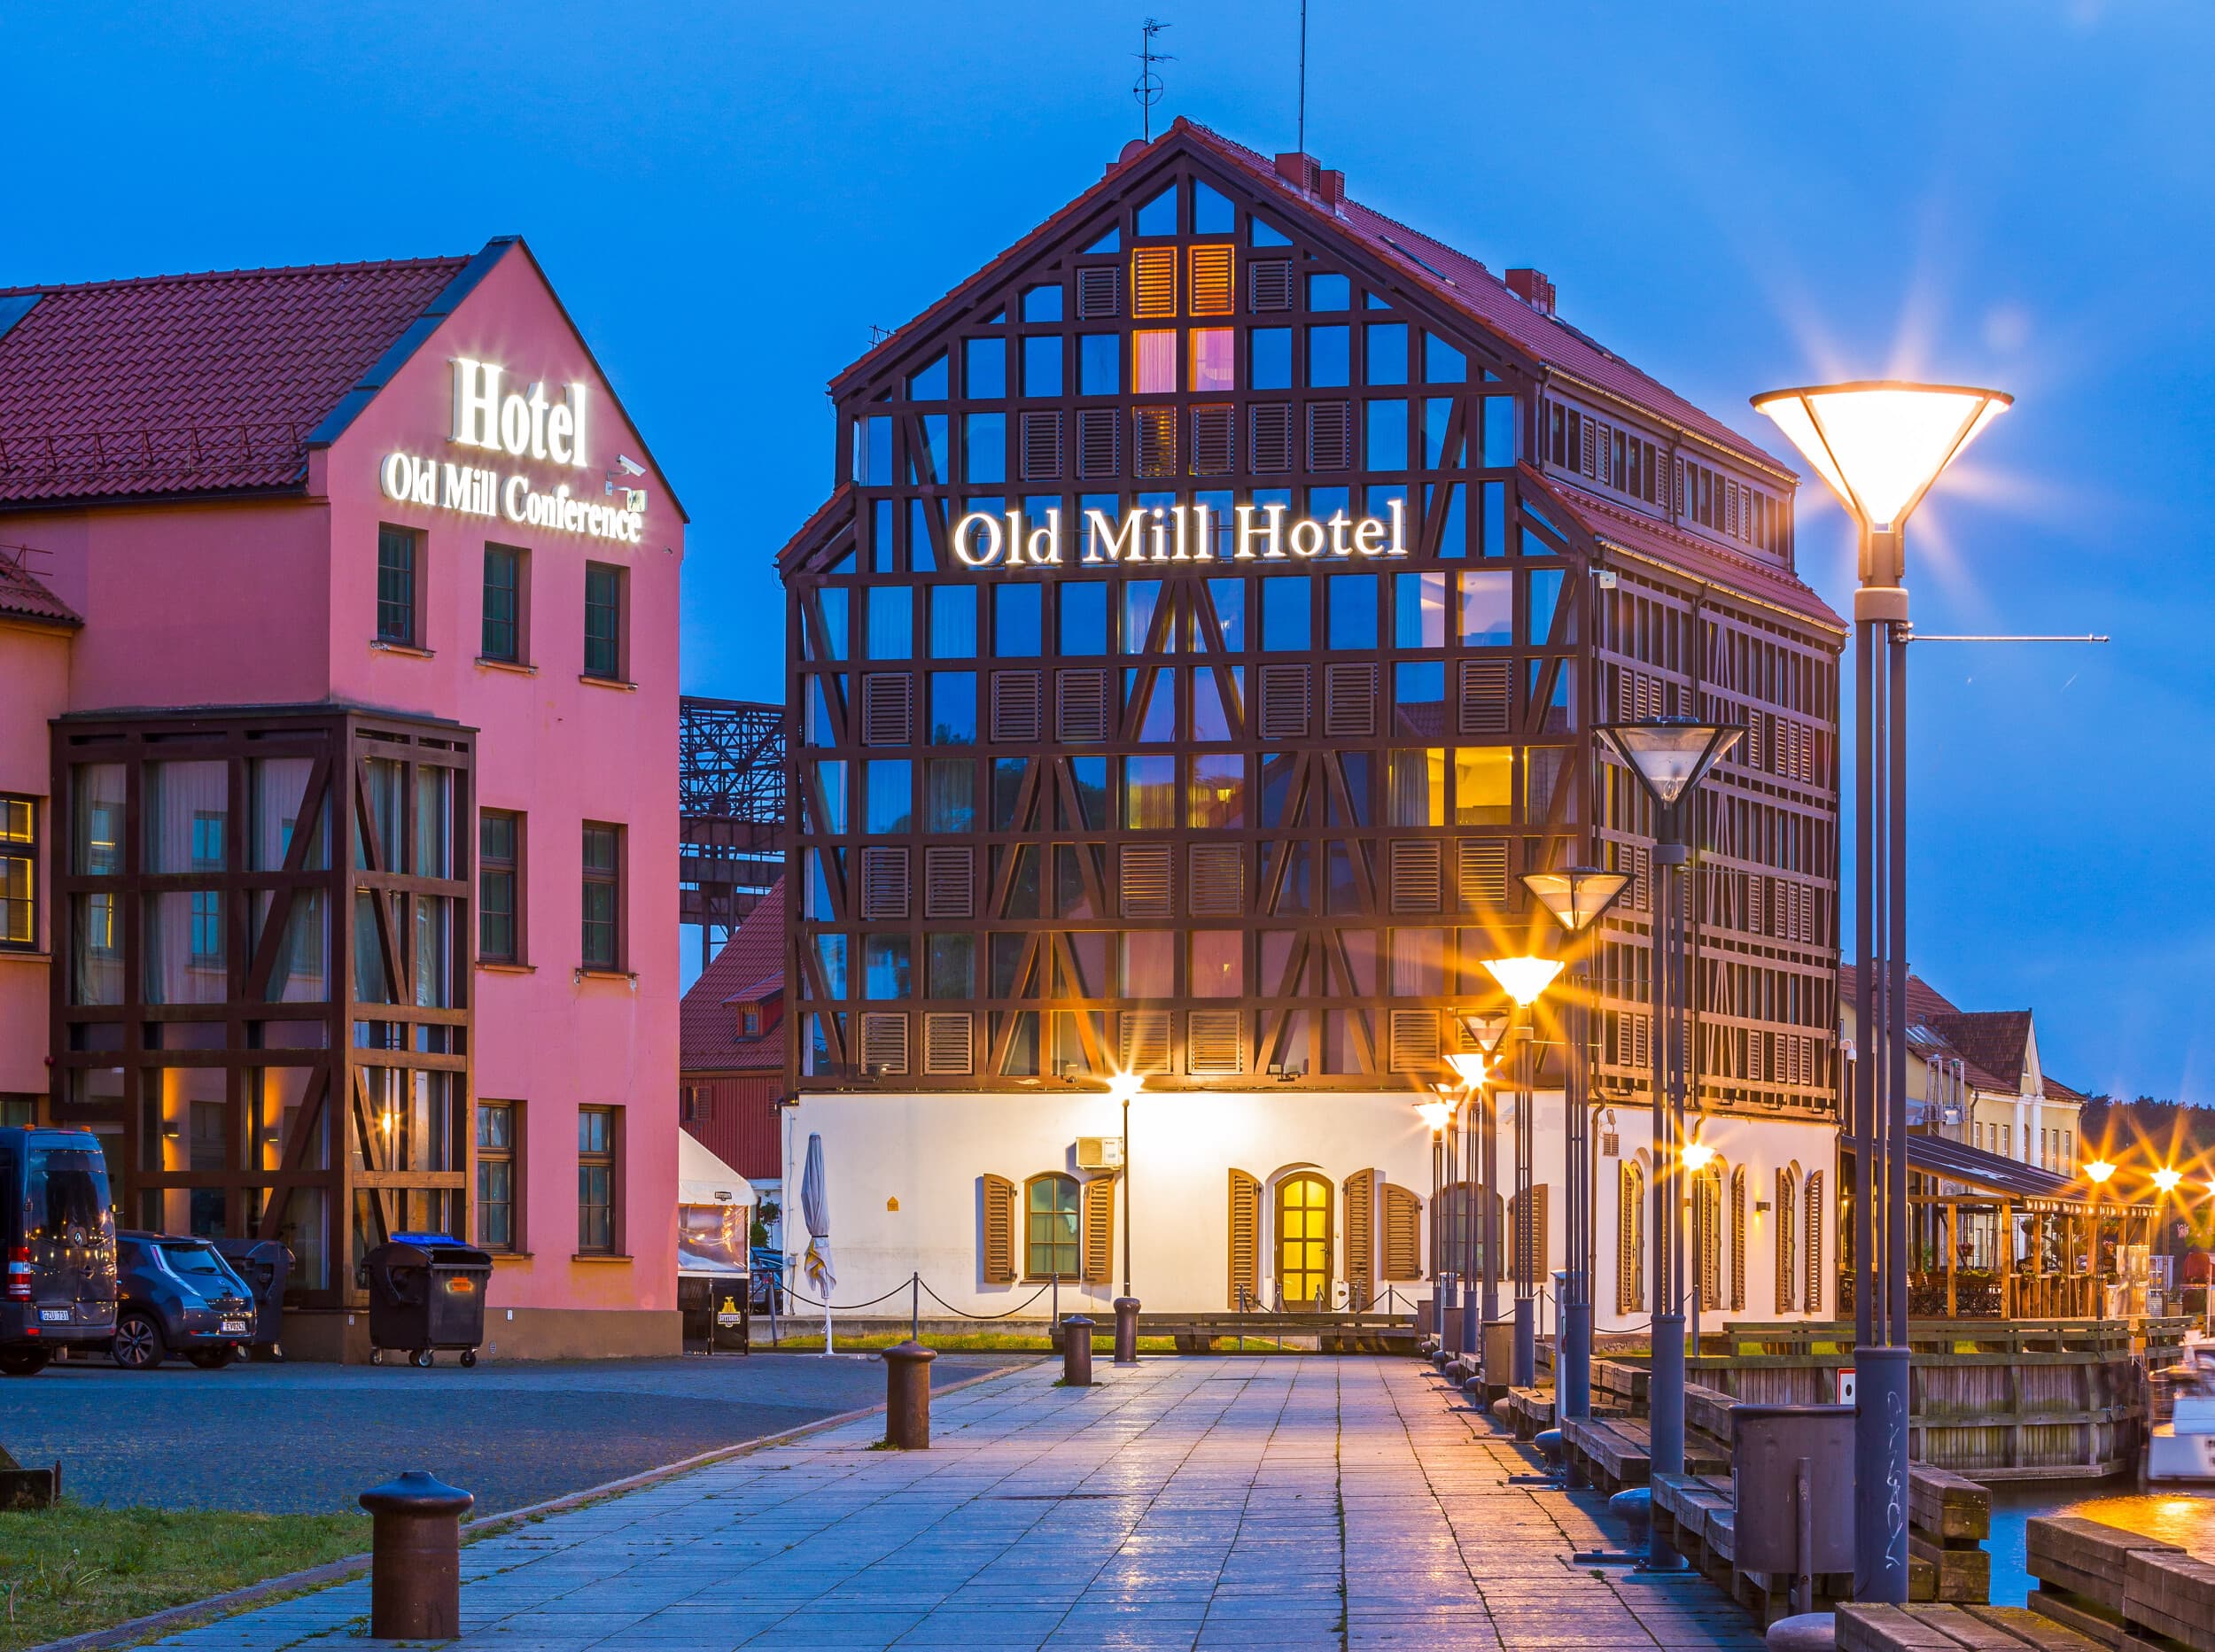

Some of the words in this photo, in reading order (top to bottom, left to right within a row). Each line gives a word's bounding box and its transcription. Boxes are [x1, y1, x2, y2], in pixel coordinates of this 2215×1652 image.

[447, 357, 587, 467] Hotel
[381, 453, 436, 506] Old
[444, 462, 497, 516] Mill
[500, 475, 642, 543] Conference
[954, 508, 1062, 565] Old
[1082, 504, 1214, 562] Mill
[1234, 500, 1408, 558] Hotel
